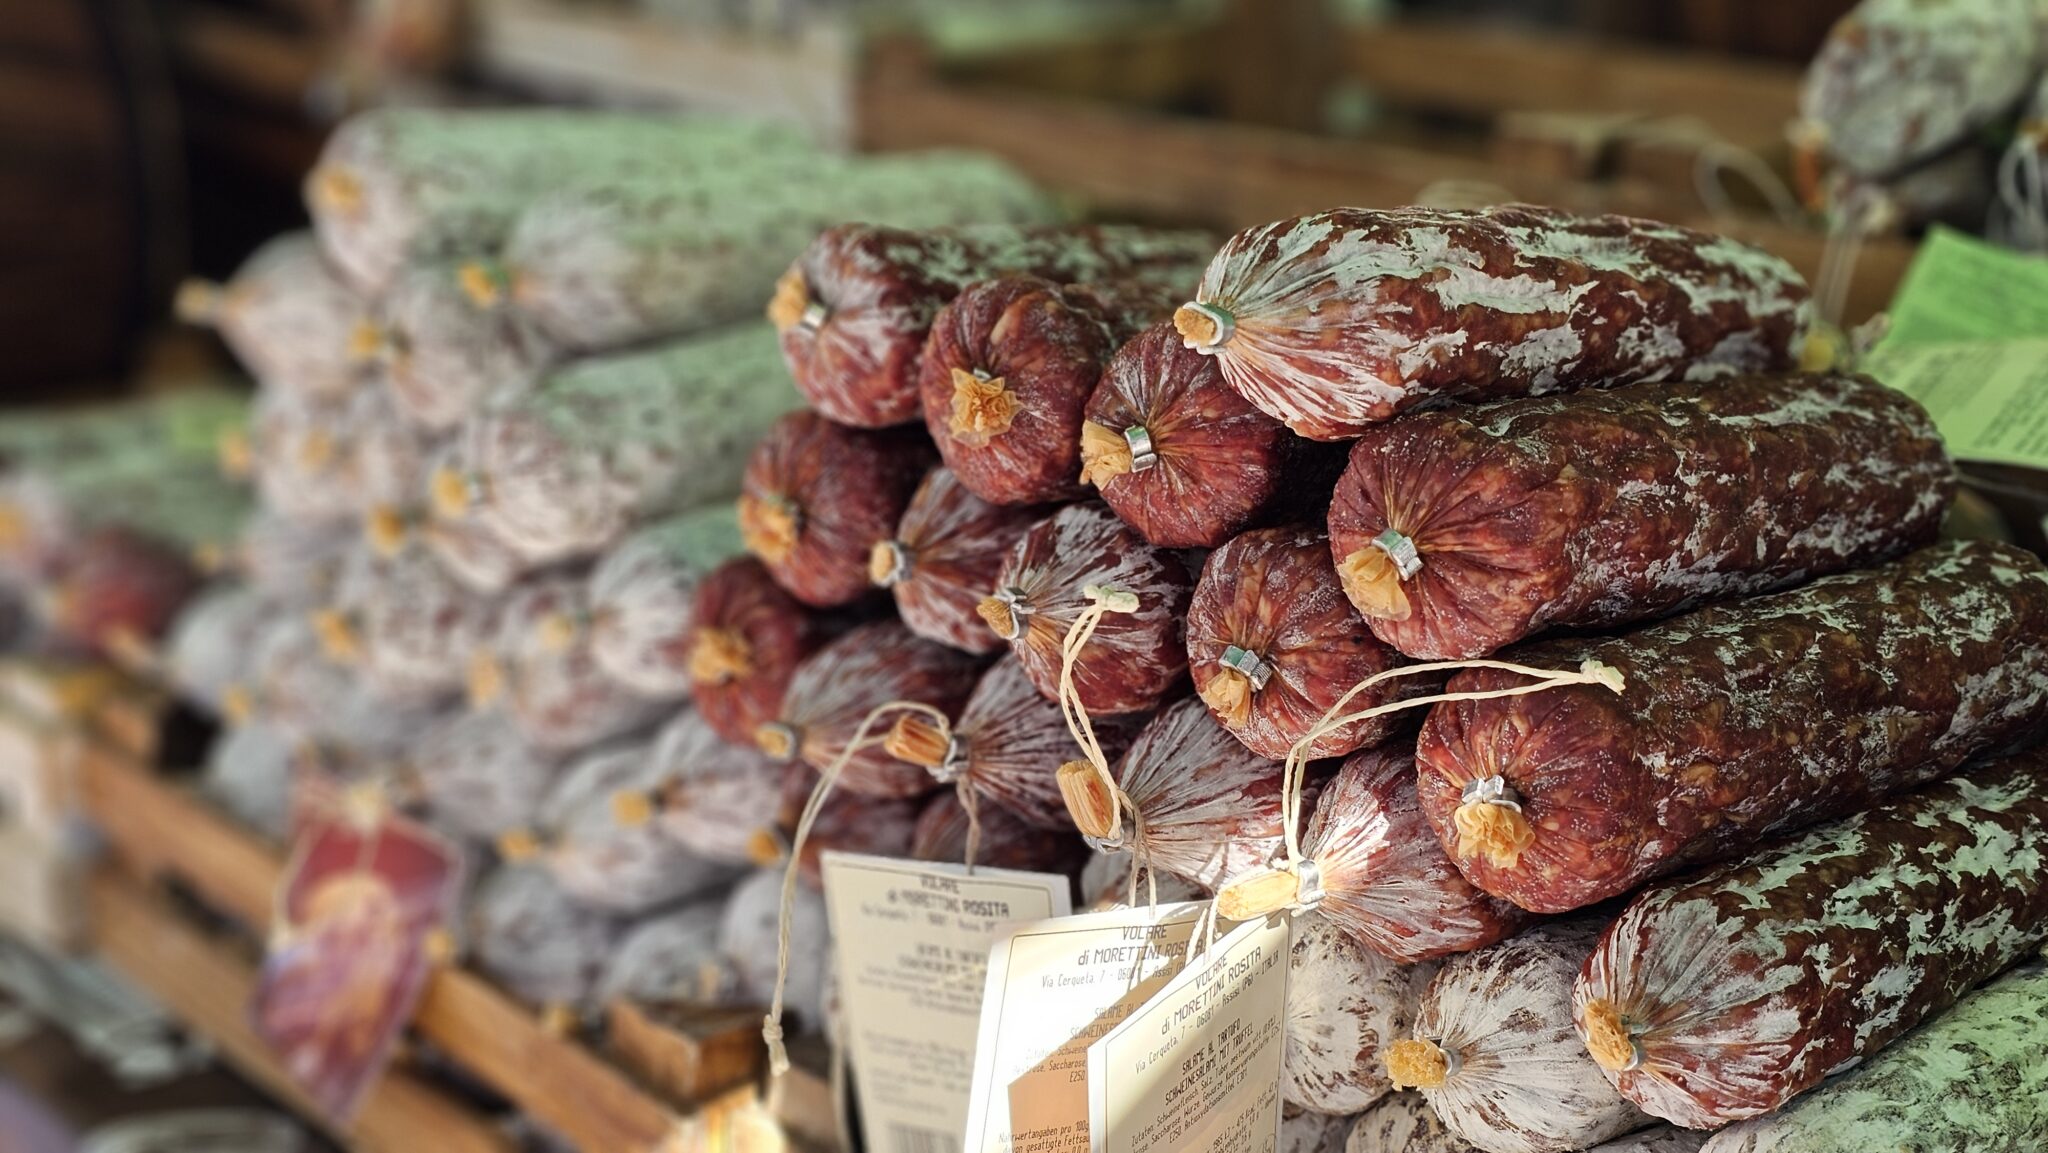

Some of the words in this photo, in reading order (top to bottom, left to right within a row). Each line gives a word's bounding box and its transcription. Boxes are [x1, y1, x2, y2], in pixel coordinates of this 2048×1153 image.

[920, 874, 960, 894] VOLARE
[963, 899, 1010, 917] ROSITA
[1122, 925, 1168, 940] VOLARE
[1078, 950, 1089, 966] di
[1094, 943, 1161, 965] MORETTINI
[1042, 975, 1053, 988] Via
[1195, 955, 1228, 990] VOLARE
[1161, 1016, 1170, 1036] di
[1173, 975, 1225, 1027] MORETTINI
[1228, 946, 1262, 984] ROSITA
[1135, 1059, 1146, 1074] Via
[1222, 987, 1241, 1007] Assisi
[1261, 949, 1279, 976] ITALIA
[1182, 1047, 1205, 1076] SALAME
[1218, 1018, 1241, 1047] TARTUFO
[1219, 1042, 1230, 1062] MIT
[1060, 1125, 1072, 1137] pro
